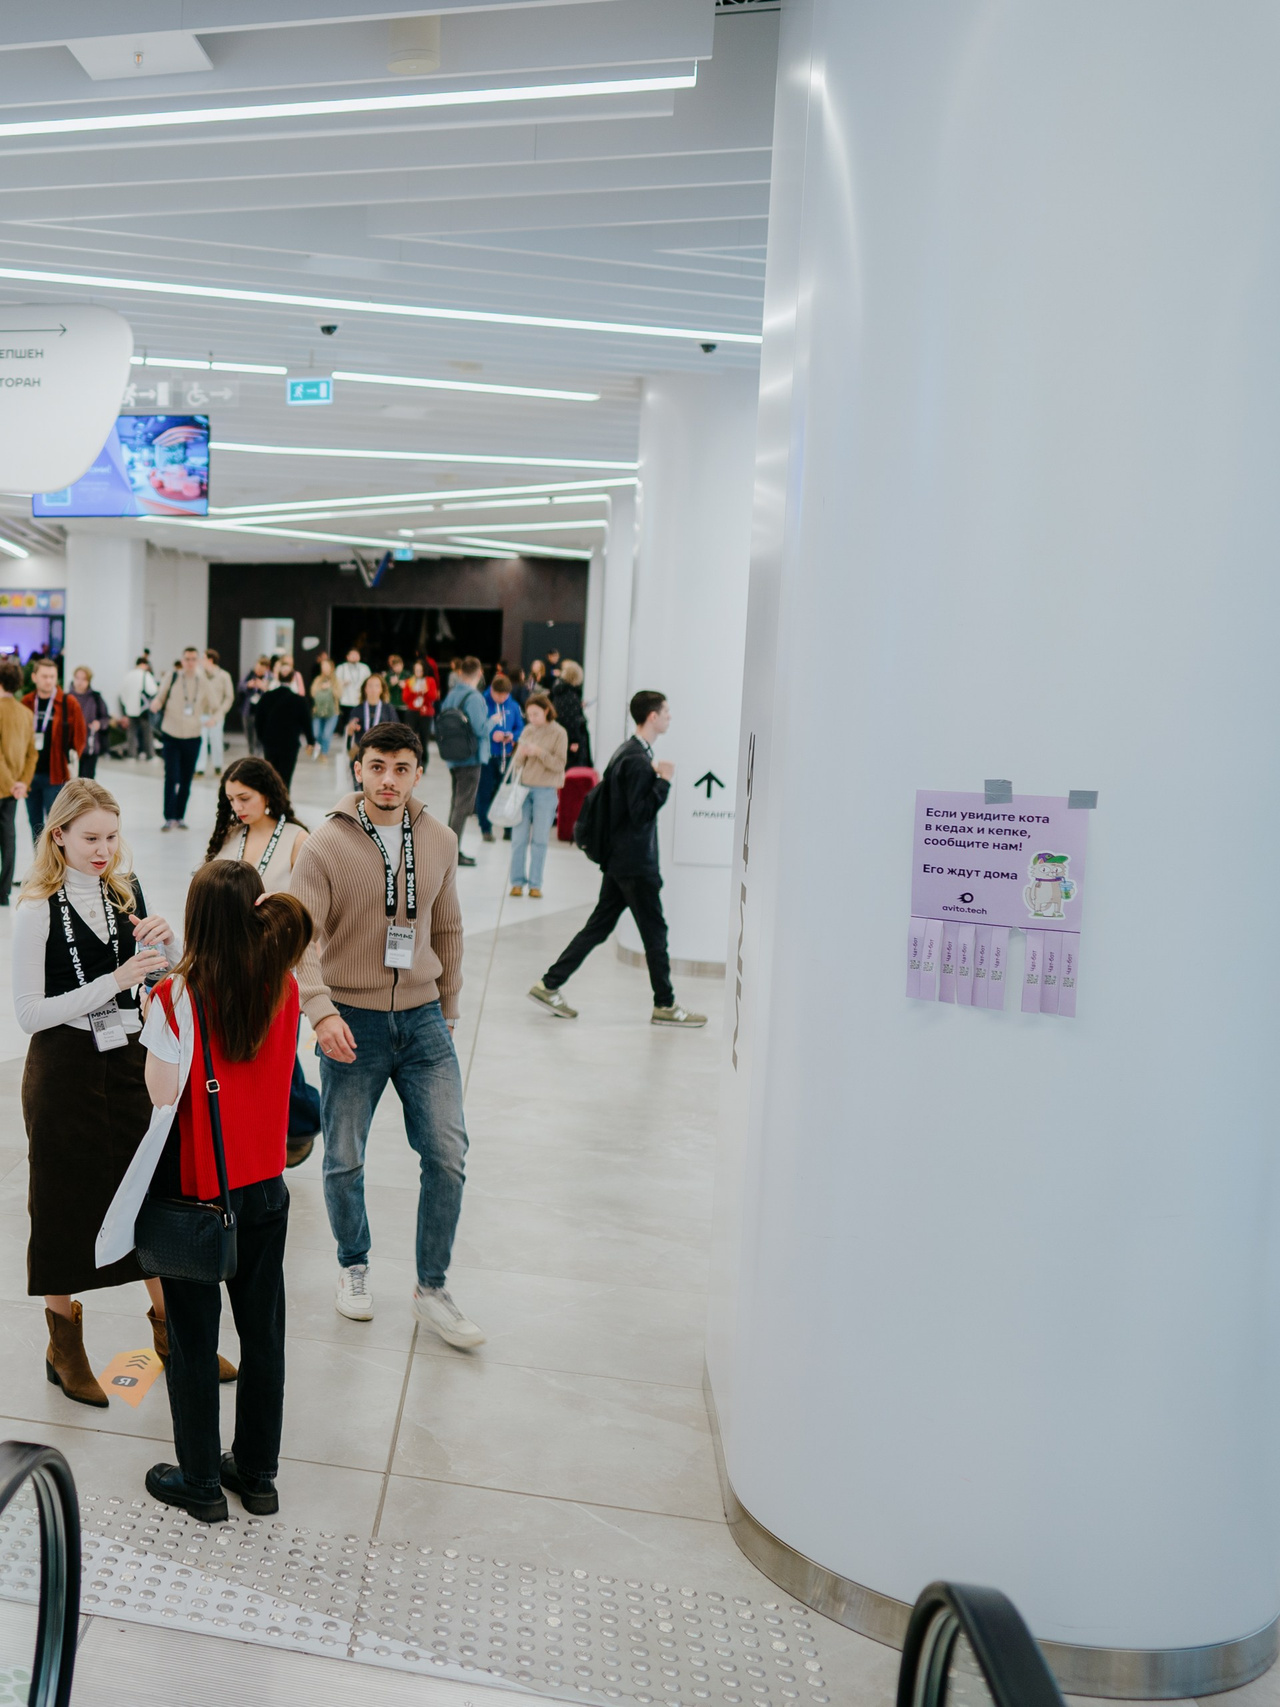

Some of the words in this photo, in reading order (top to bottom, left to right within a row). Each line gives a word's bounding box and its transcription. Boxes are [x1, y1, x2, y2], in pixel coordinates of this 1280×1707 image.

[692, 810, 735, 819] АРХАНГЕ
[926, 808, 957, 818] Если
[961, 811, 1015, 822] увидите
[1019, 815, 1050, 824] кота
[935, 824, 973, 833] кедах
[988, 828, 1031, 839] кепке,
[924, 838, 989, 849] сообщите
[992, 842, 1023, 851] нам!
[923, 863, 944, 874] Его
[947, 867, 981, 879] ждут
[983, 871, 1018, 880] дома
[942, 905, 987, 915] avito.tech
